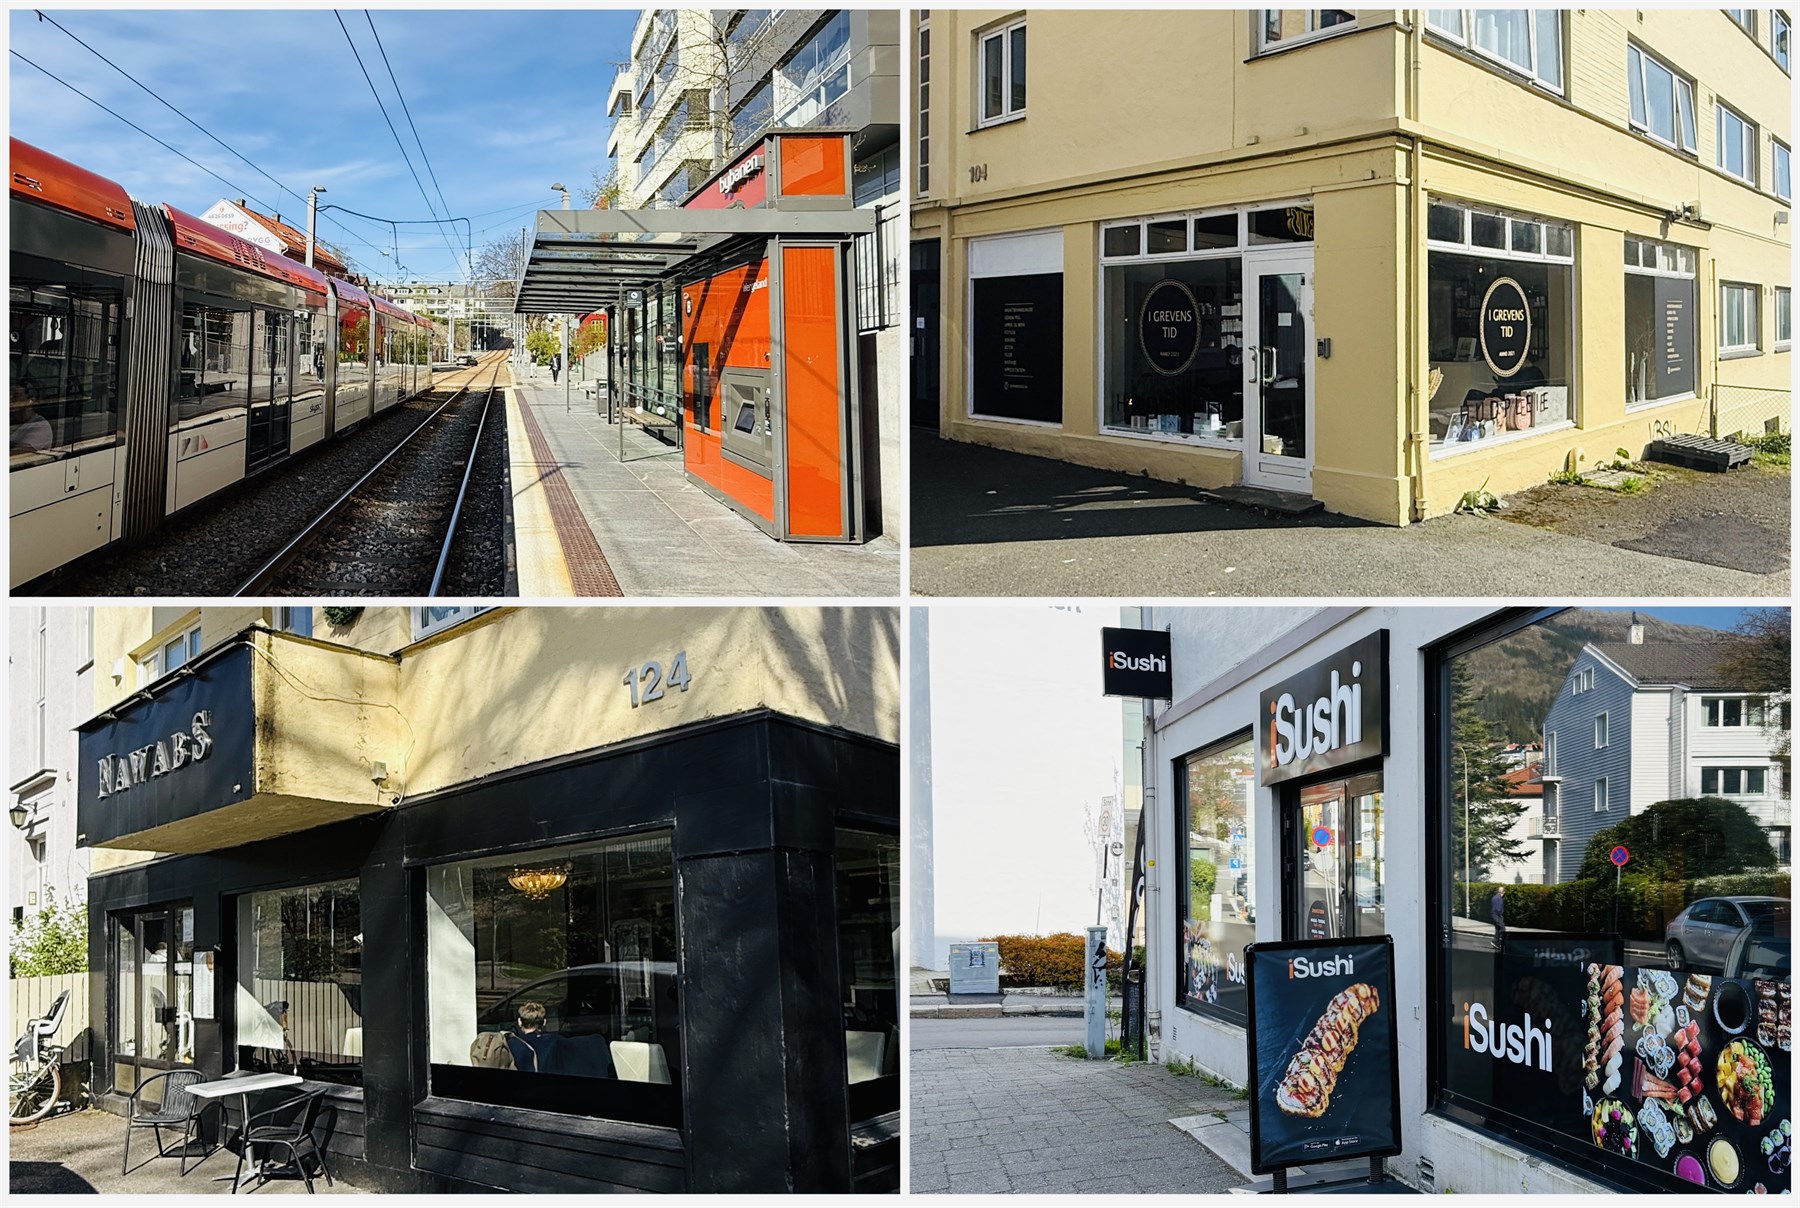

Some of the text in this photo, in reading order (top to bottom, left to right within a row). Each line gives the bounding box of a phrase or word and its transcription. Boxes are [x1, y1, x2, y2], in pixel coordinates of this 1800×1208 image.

[719, 154, 759, 194] bybanen
[968, 163, 988, 184] 104
[1148, 310, 1192, 322] I GREVENS
[1488, 308, 1524, 321] I GREVENS
[1162, 326, 1178, 338] TID
[1500, 325, 1514, 338] TID
[1109, 650, 1166, 672] iSushi
[622, 650, 692, 709] 124
[1270, 660, 1362, 769] iSushi
[97, 710, 212, 800] NAWABS
[1288, 954, 1354, 980] iSushi
[1463, 1001, 1553, 1073] iSushi
